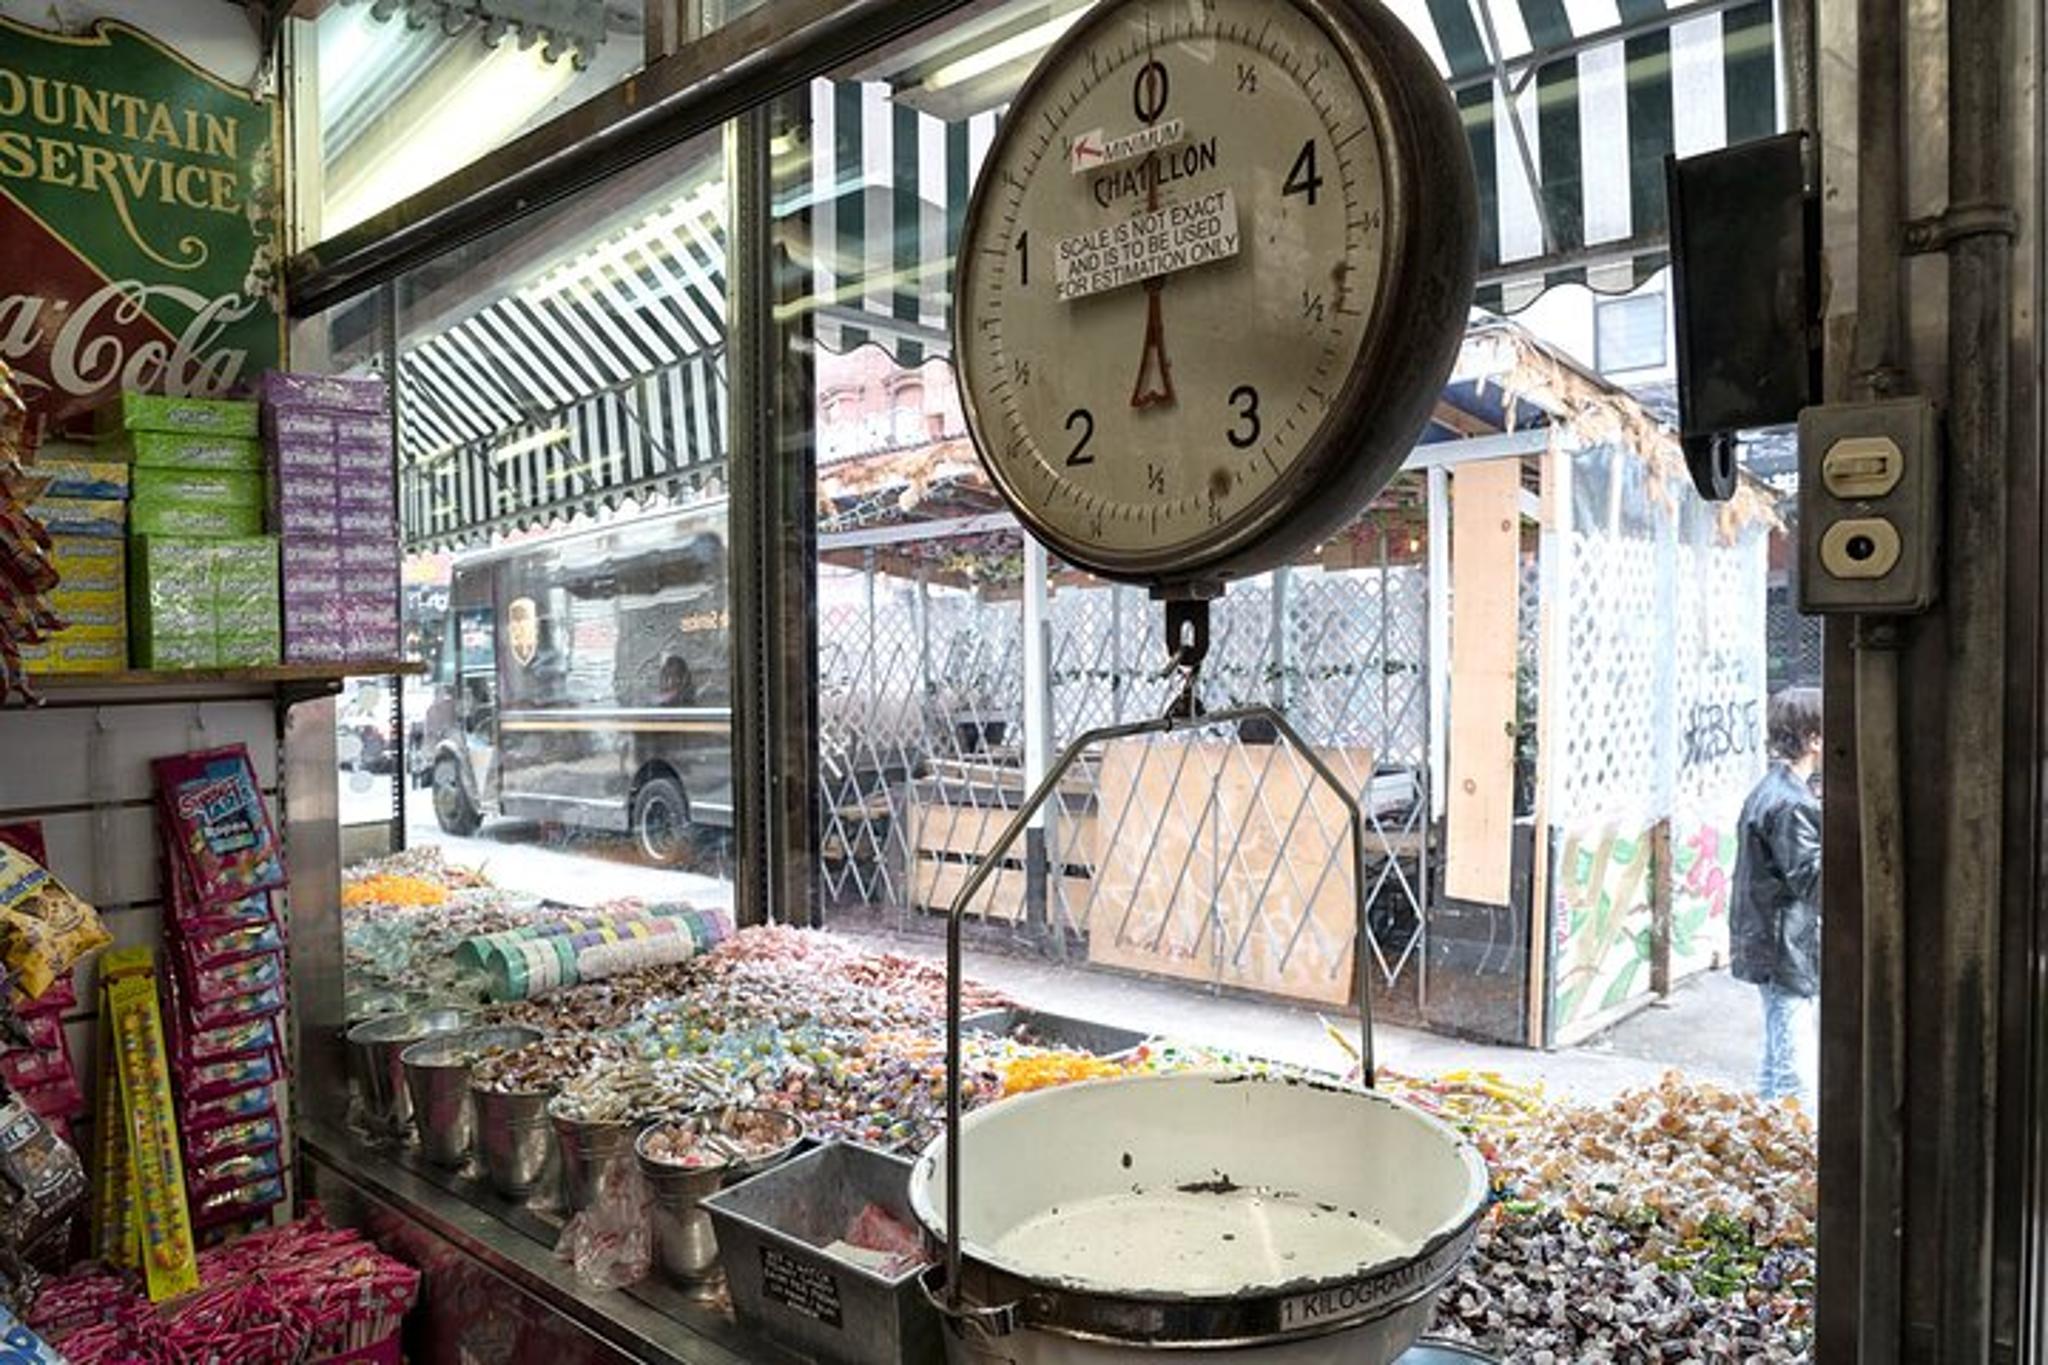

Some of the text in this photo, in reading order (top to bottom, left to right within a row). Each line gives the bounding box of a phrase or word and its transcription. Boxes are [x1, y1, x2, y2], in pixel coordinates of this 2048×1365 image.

[1134, 60, 1169, 123] 0
[1104, 123, 1180, 161] MINIMUM
[1282, 138, 1324, 206] 4
[0, 132, 244, 250] SERVICE
[1060, 229, 1111, 259] SCALE
[1115, 224, 1129, 244] IS
[1132, 212, 1166, 236] NOT
[1171, 192, 1226, 226] EXACT
[1069, 216, 1221, 276] AND IS TO BE USED
[1014, 230, 1030, 287] 1
[1057, 234, 1237, 297] FOR ESTIMATION ONLY
[1065, 408, 1095, 466] 2
[1226, 385, 1262, 449] 3
[1282, 1300, 1293, 1323] 1
